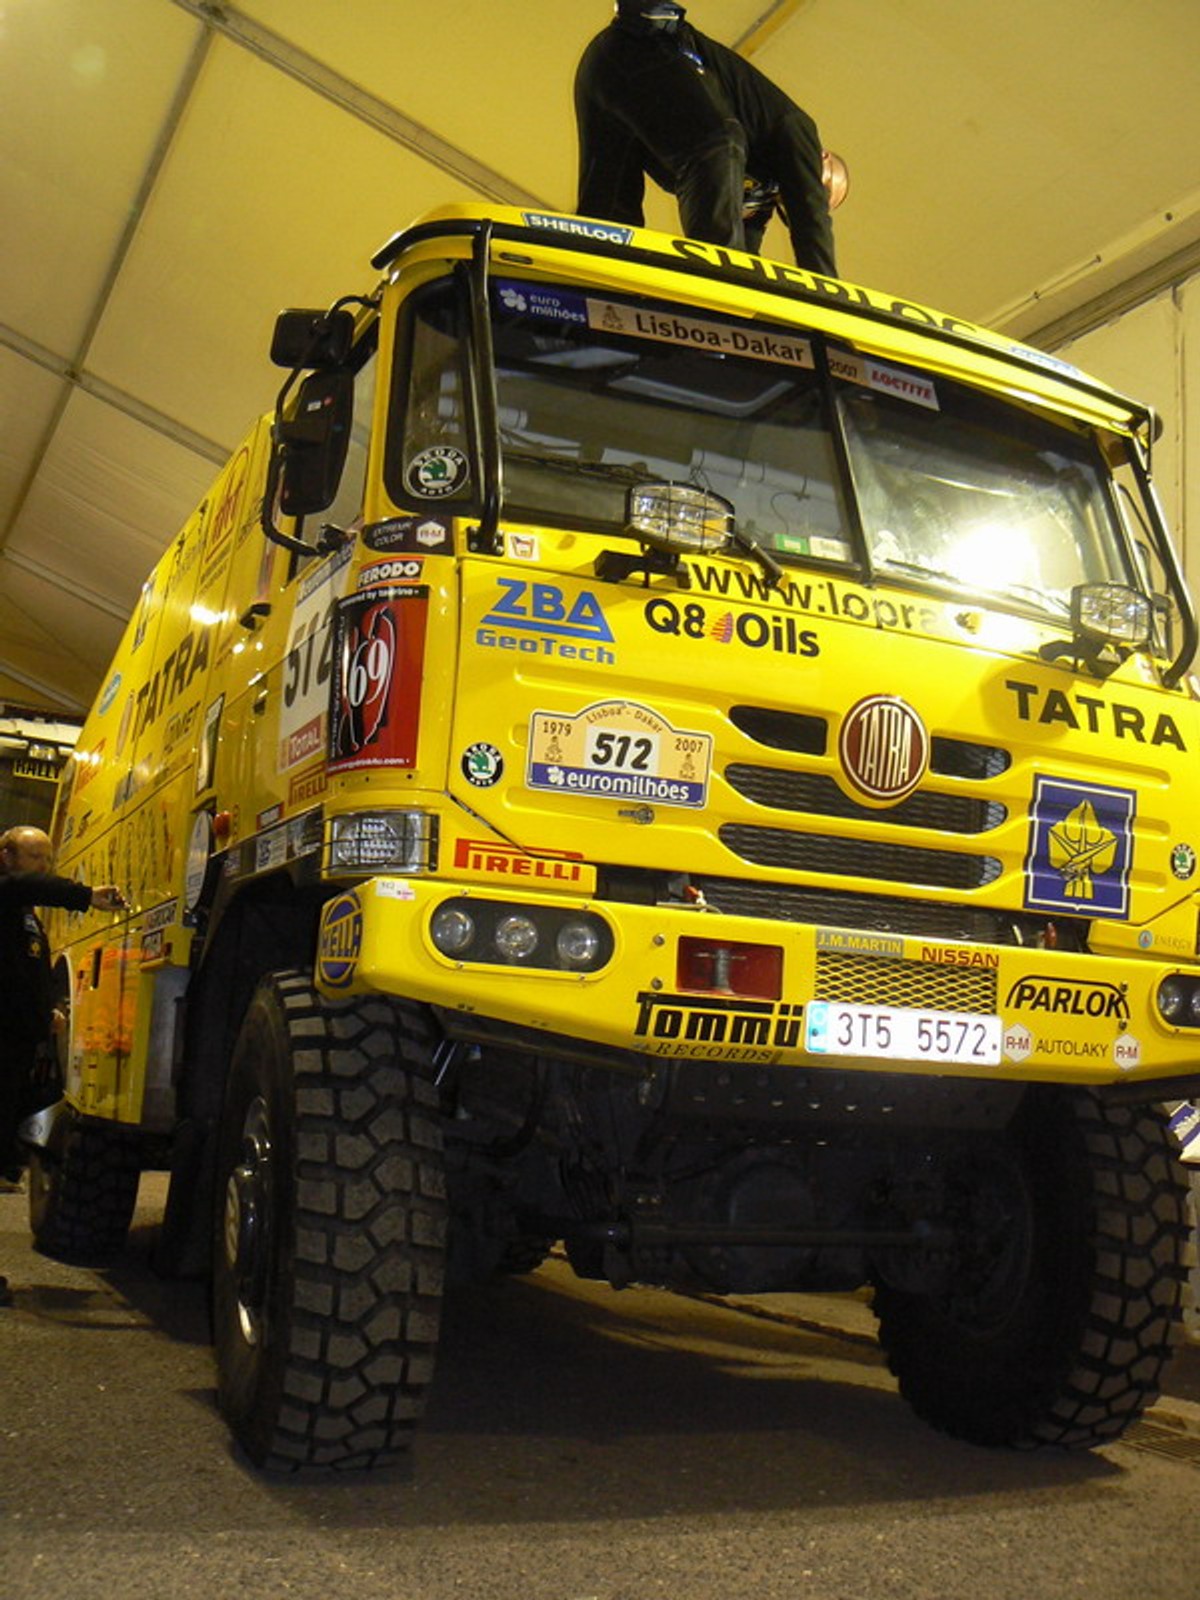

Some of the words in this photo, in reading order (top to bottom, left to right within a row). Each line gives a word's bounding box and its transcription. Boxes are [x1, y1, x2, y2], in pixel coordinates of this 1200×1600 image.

[529, 214, 625, 244] SHERLOG
[530, 294, 560, 307] euro
[530, 303, 586, 323] milhões
[635, 312, 804, 363] Lisboa-Dakar
[870, 367, 933, 401] LOCTITE
[358, 561, 420, 589] FERODO
[490, 576, 615, 643] ZBA
[643, 597, 706, 639] Q8
[735, 611, 821, 658] Oils
[475, 628, 616, 665] GeoTech
[131, 627, 210, 743] TATRA
[542, 720, 572, 736] 1979
[633, 709, 664, 734] Dakar
[1004, 679, 1188, 753] TATRA
[591, 732, 654, 771] 512
[674, 737, 704, 754] 2007
[858, 703, 912, 790] TATRA
[566, 770, 690, 801] euromilhões
[453, 837, 585, 882] PIRELLI
[921, 946, 1000, 968] NISSAN
[1013, 983, 1122, 1019] PARLOK
[654, 1041, 774, 1062] RECORDS
[837, 1012, 892, 1049] 3T5
[917, 1018, 988, 1057] 5572
[1006, 1035, 1030, 1051] R-M
[1036, 1038, 1109, 1058] AUTOLAKY
